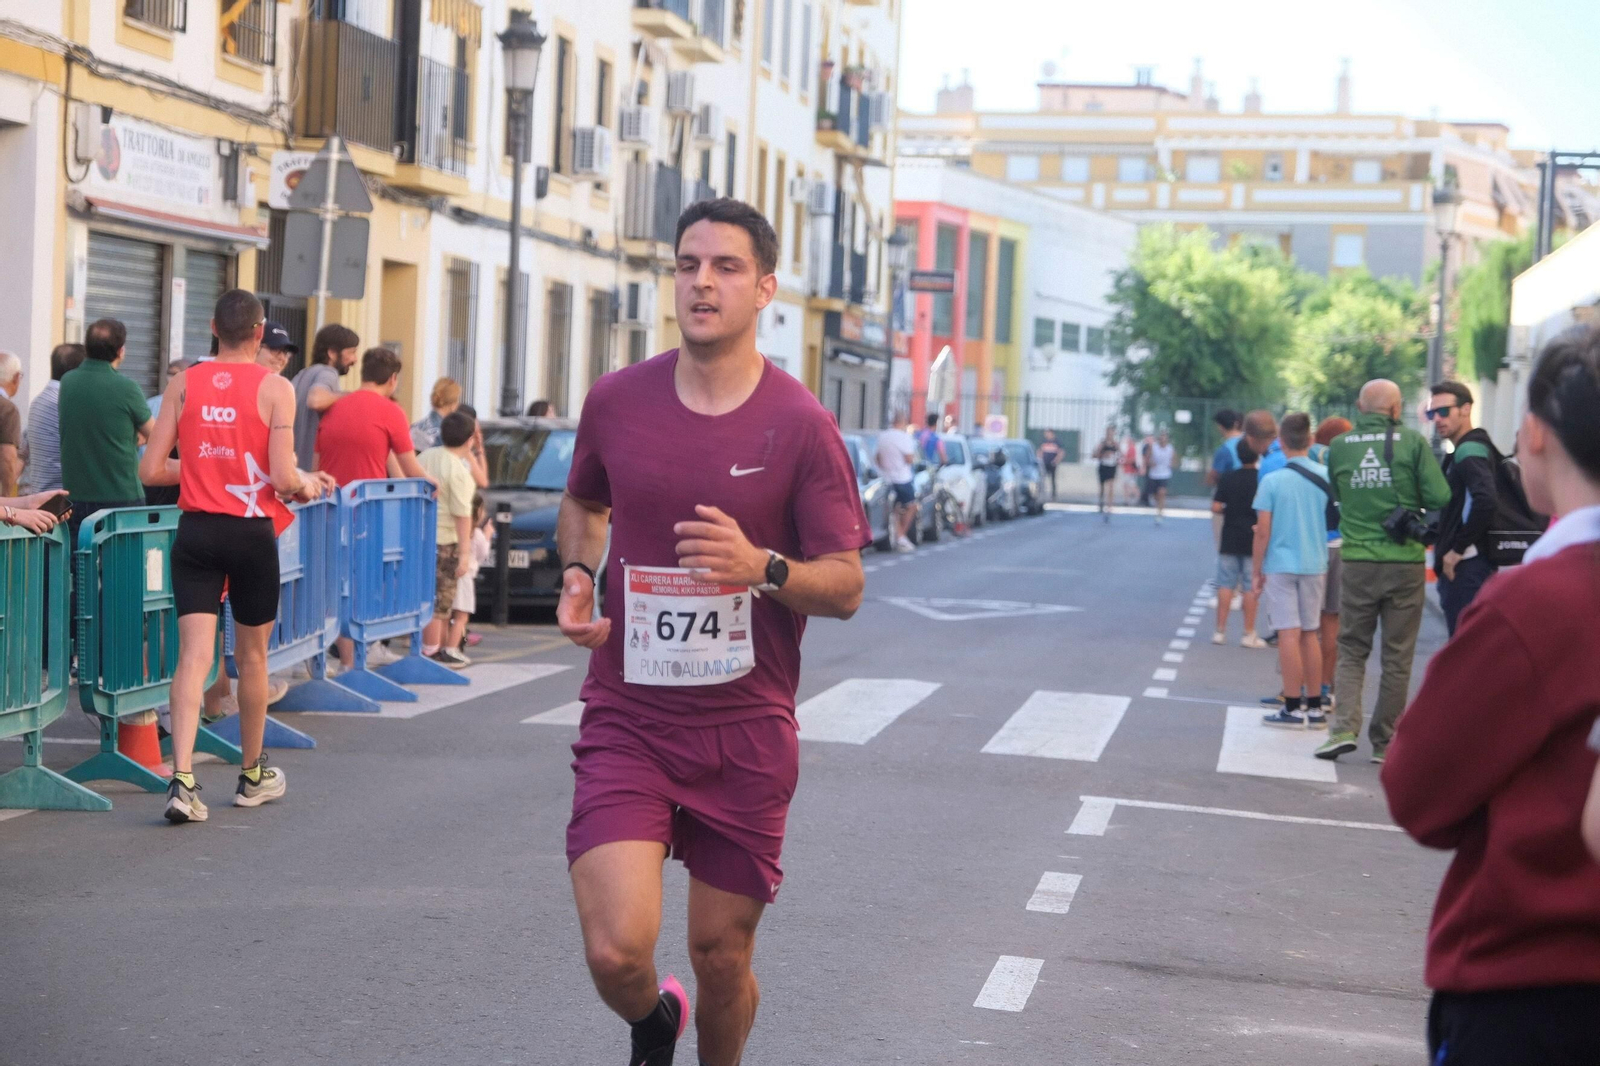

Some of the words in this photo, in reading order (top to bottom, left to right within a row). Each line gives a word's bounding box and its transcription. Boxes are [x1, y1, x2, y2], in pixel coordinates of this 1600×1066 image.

[123, 127, 174, 160] TRATTORIA
[201, 405, 237, 423] UCO
[207, 445, 236, 457] califas
[1350, 467, 1392, 483] AIRE
[640, 575, 673, 585] CARRERA
[651, 586, 679, 595] MEMORIAL
[681, 586, 696, 595] KIKO
[656, 610, 721, 642] 674
